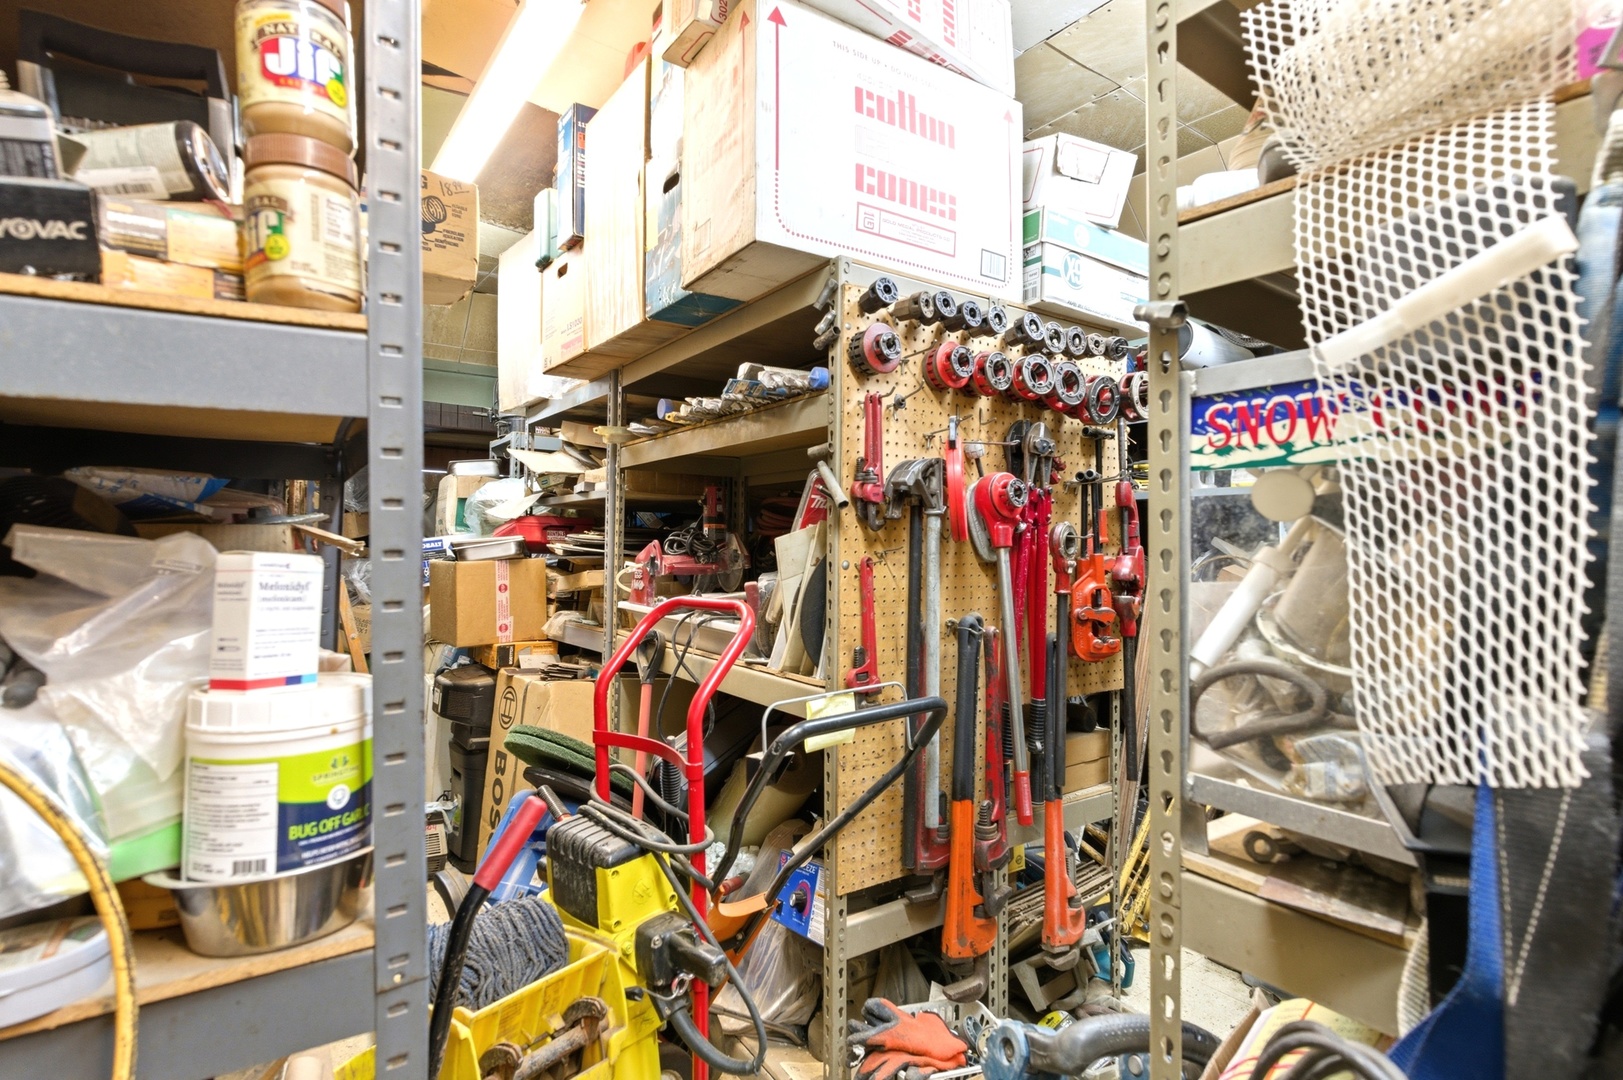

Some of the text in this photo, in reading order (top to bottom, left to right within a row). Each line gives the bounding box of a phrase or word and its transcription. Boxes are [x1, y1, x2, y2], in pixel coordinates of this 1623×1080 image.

[832, 40, 849, 54] THIS
[852, 49, 868, 61] SIDE
[871, 57, 881, 66] UP
[854, 86, 955, 149] cotton
[855, 162, 956, 222] cones
[1207, 391, 1347, 449] SNOW
[288, 821, 318, 841] BUG
[318, 814, 342, 834] OFF
[488, 749, 508, 850] BOS
